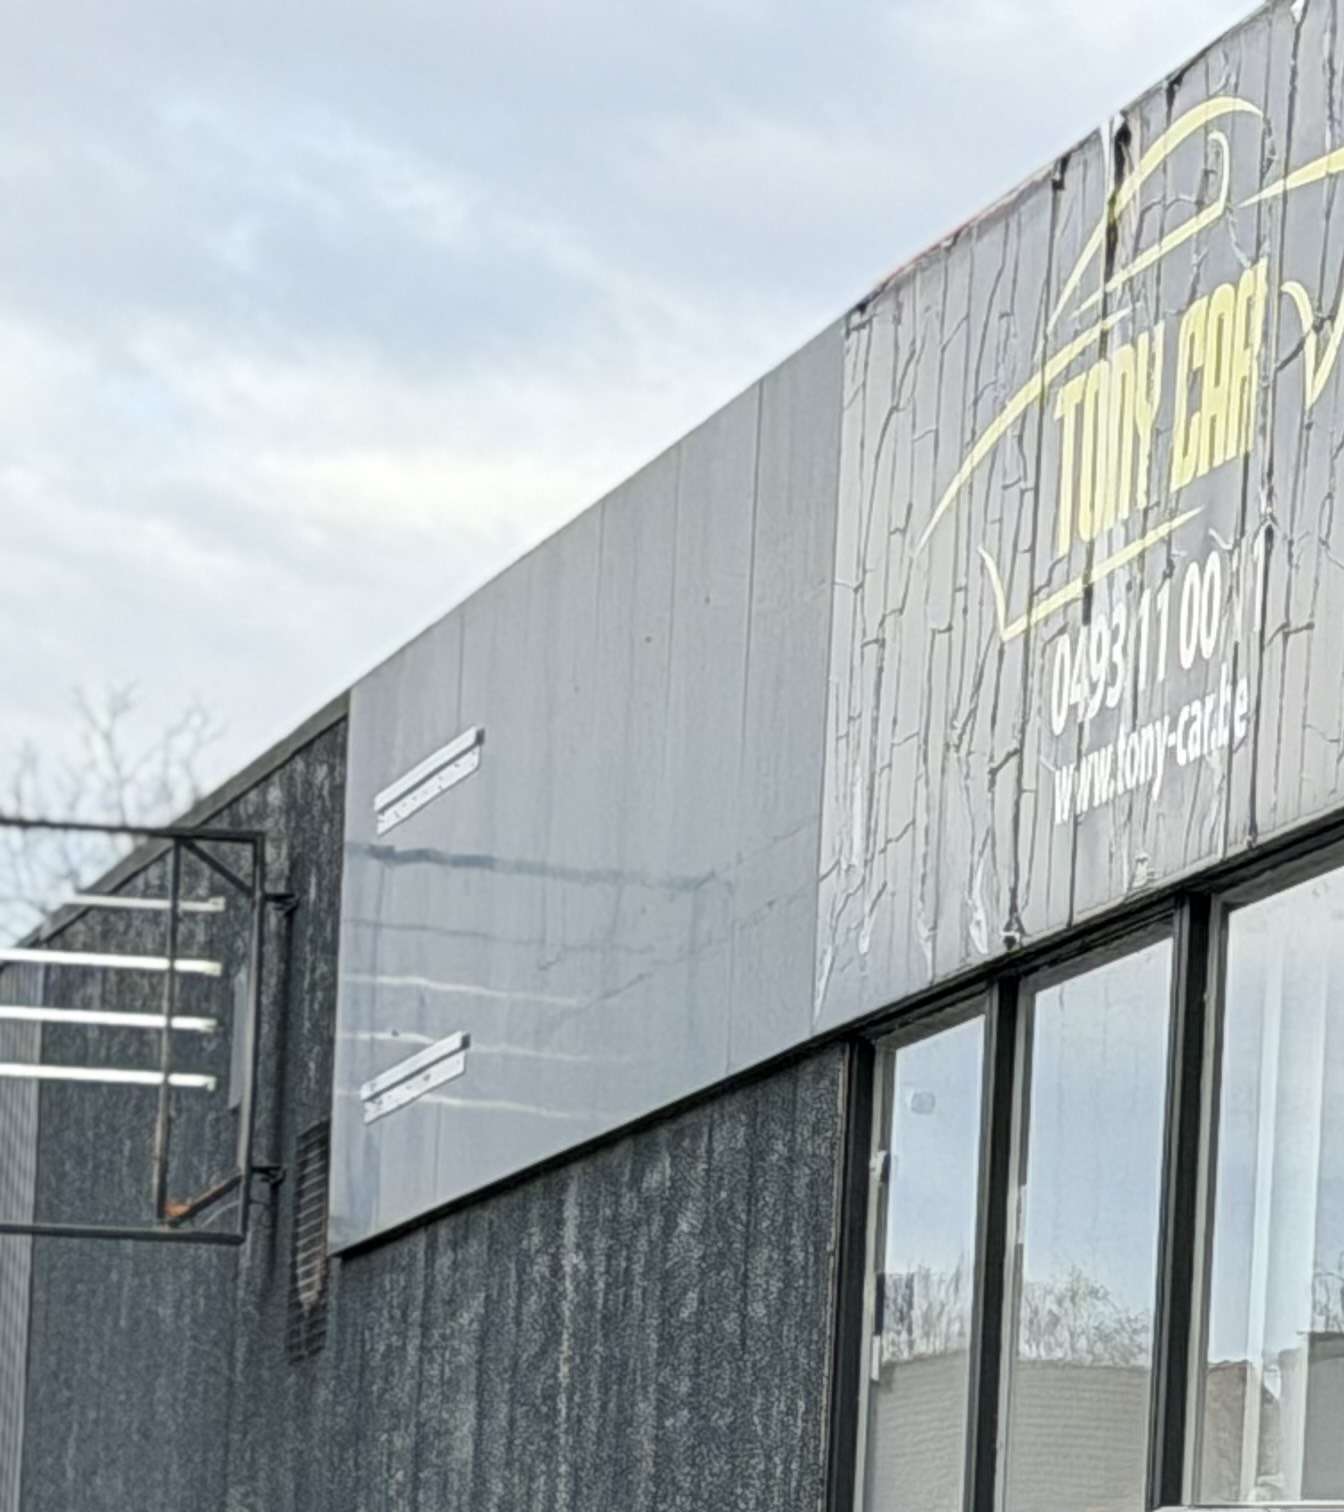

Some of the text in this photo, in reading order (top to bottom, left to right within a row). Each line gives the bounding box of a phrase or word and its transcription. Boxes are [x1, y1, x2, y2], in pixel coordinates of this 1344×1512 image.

[1054, 256, 1268, 558] TONY CAR
[1051, 600, 1127, 736] 0493
[1180, 551, 1221, 670] 00
[1054, 663, 1249, 825] www.tony-car.be
